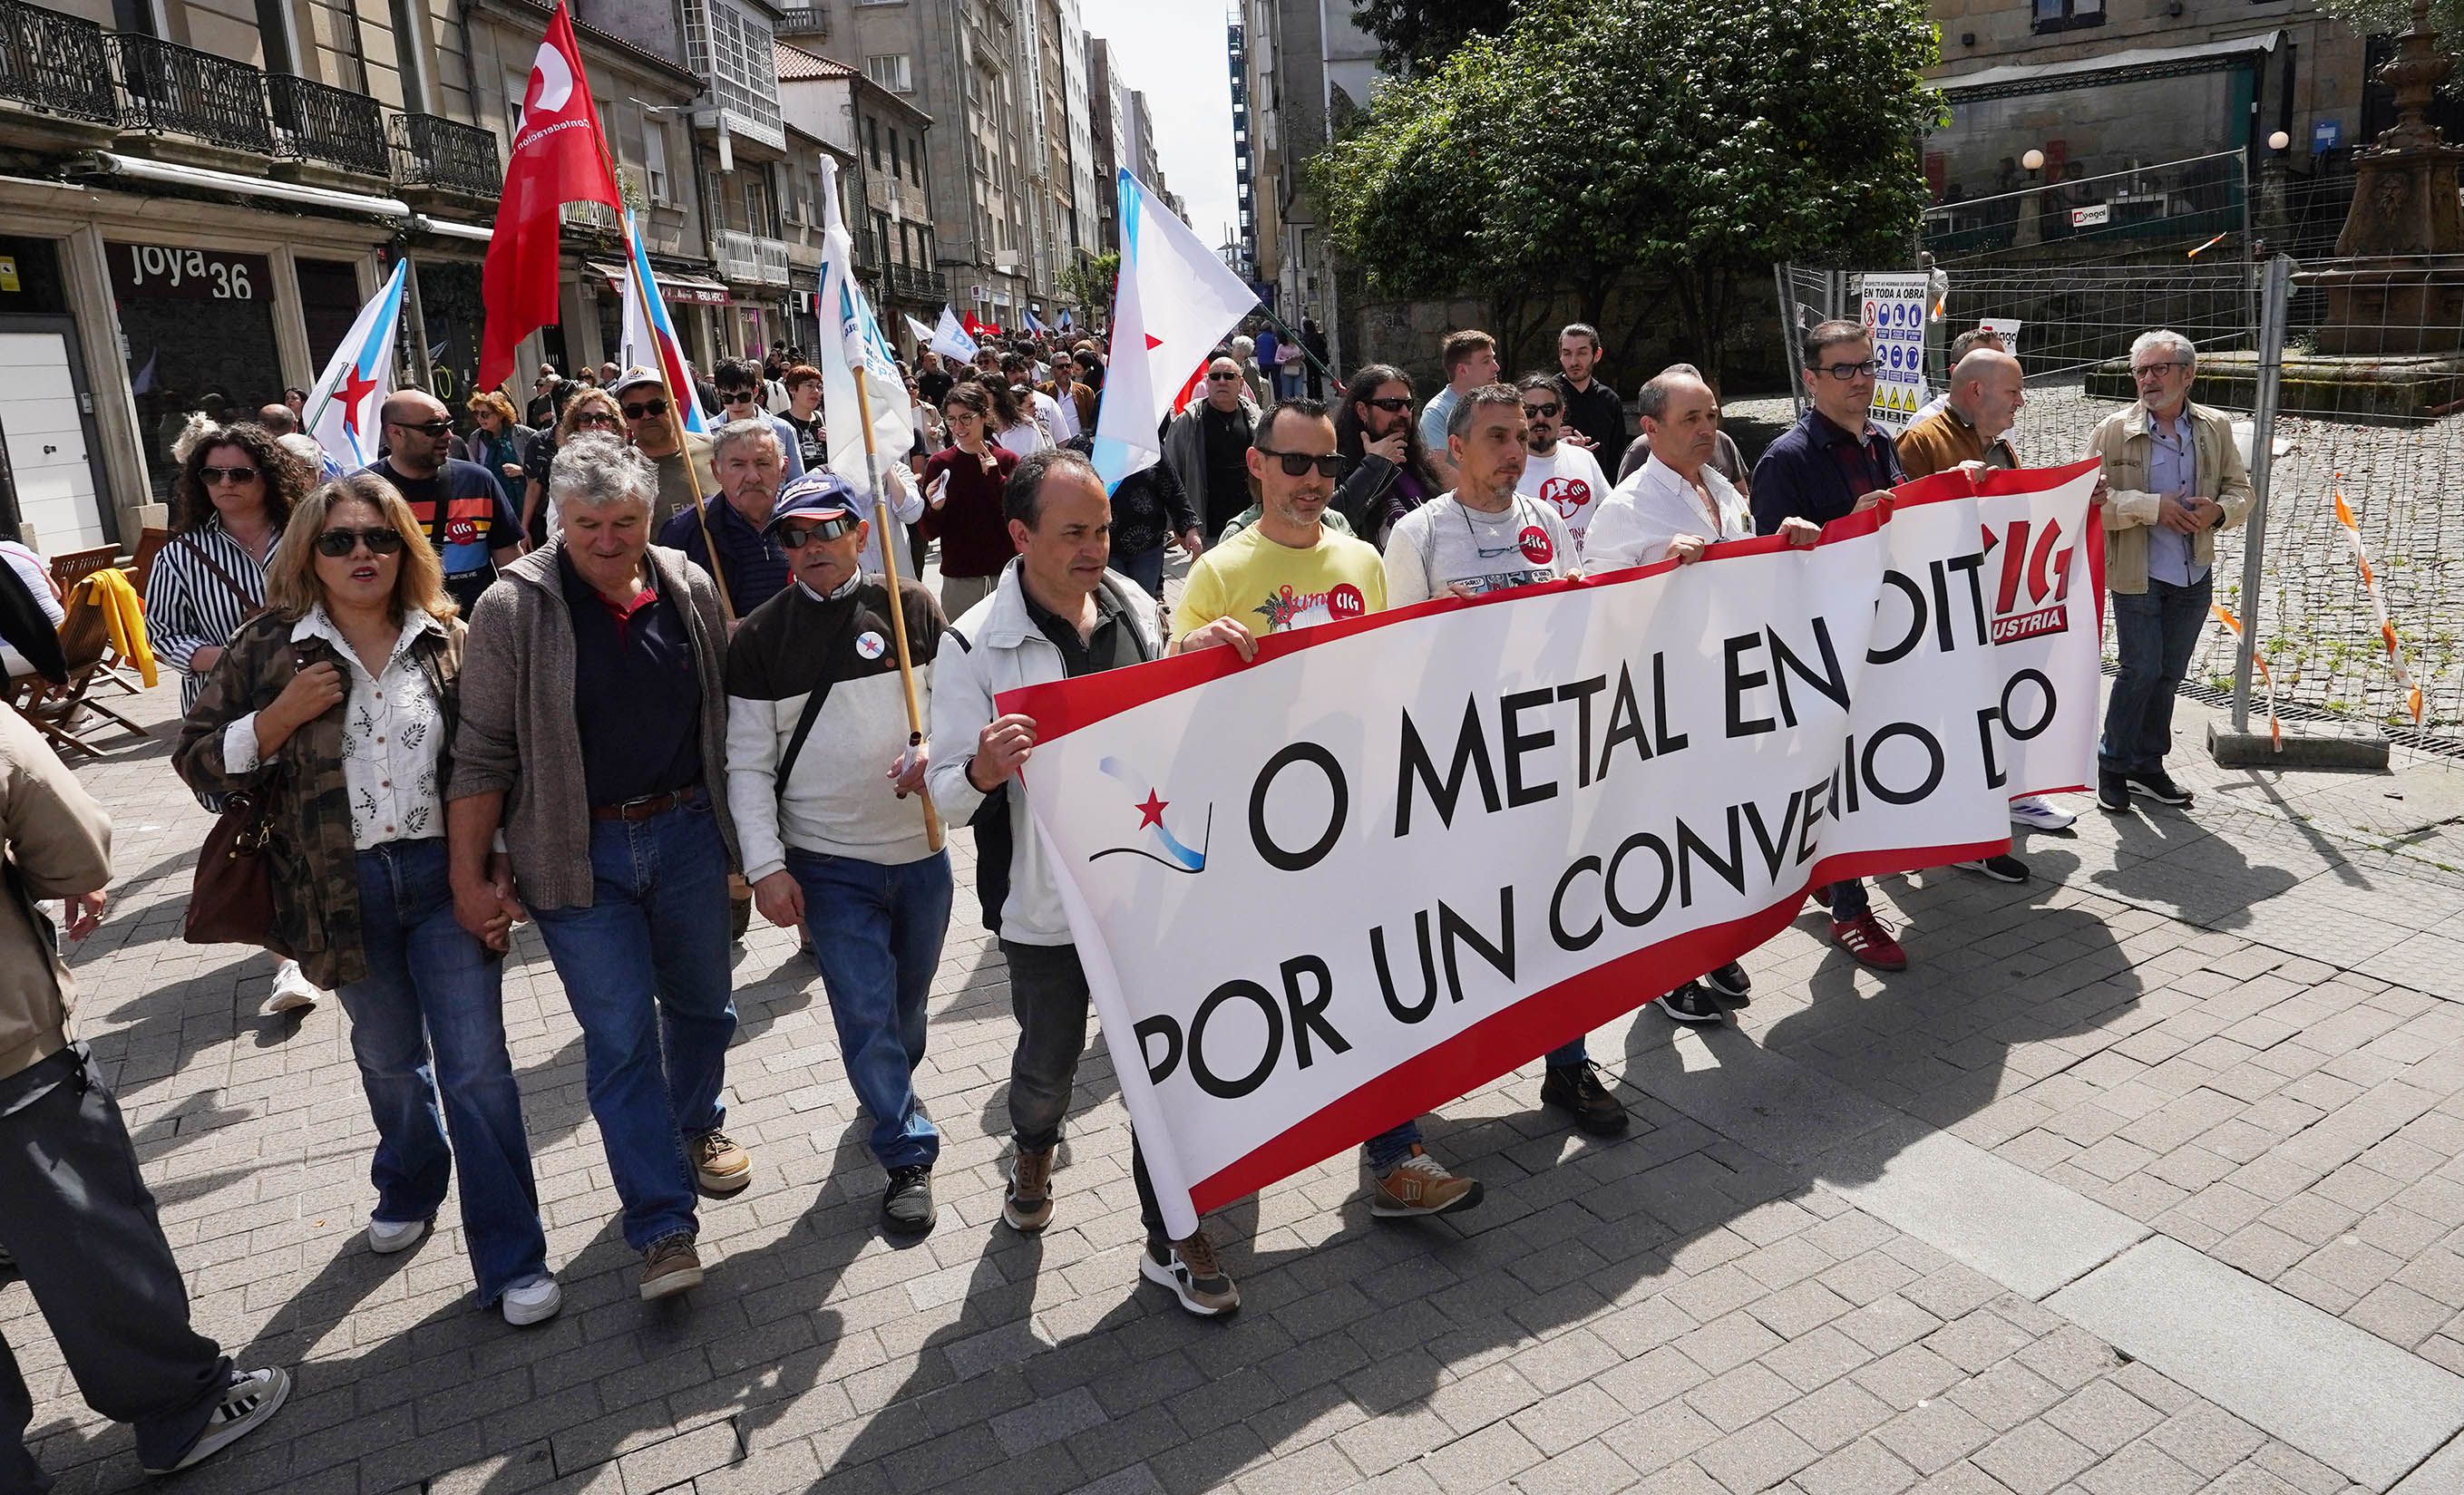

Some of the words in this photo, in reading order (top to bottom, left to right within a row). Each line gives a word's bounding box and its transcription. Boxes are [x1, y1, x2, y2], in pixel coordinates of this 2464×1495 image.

[131, 246, 206, 286] joya
[209, 262, 252, 299] 36
[1864, 288, 1874, 298] EN
[1875, 288, 1894, 299] TODA
[1895, 288, 1902, 299] A
[1904, 288, 1924, 299] OBRA
[452, 522, 472, 535] CIG
[1982, 516, 2074, 617] IG
[1337, 593, 1359, 611] CIG
[1993, 609, 2061, 640] USTRIA
[1249, 742, 1349, 870] O
[1395, 653, 1689, 839] METAL
[1724, 616, 1851, 739] EN
[1133, 954, 1353, 1100] POR
[1369, 884, 1515, 1024] UN
